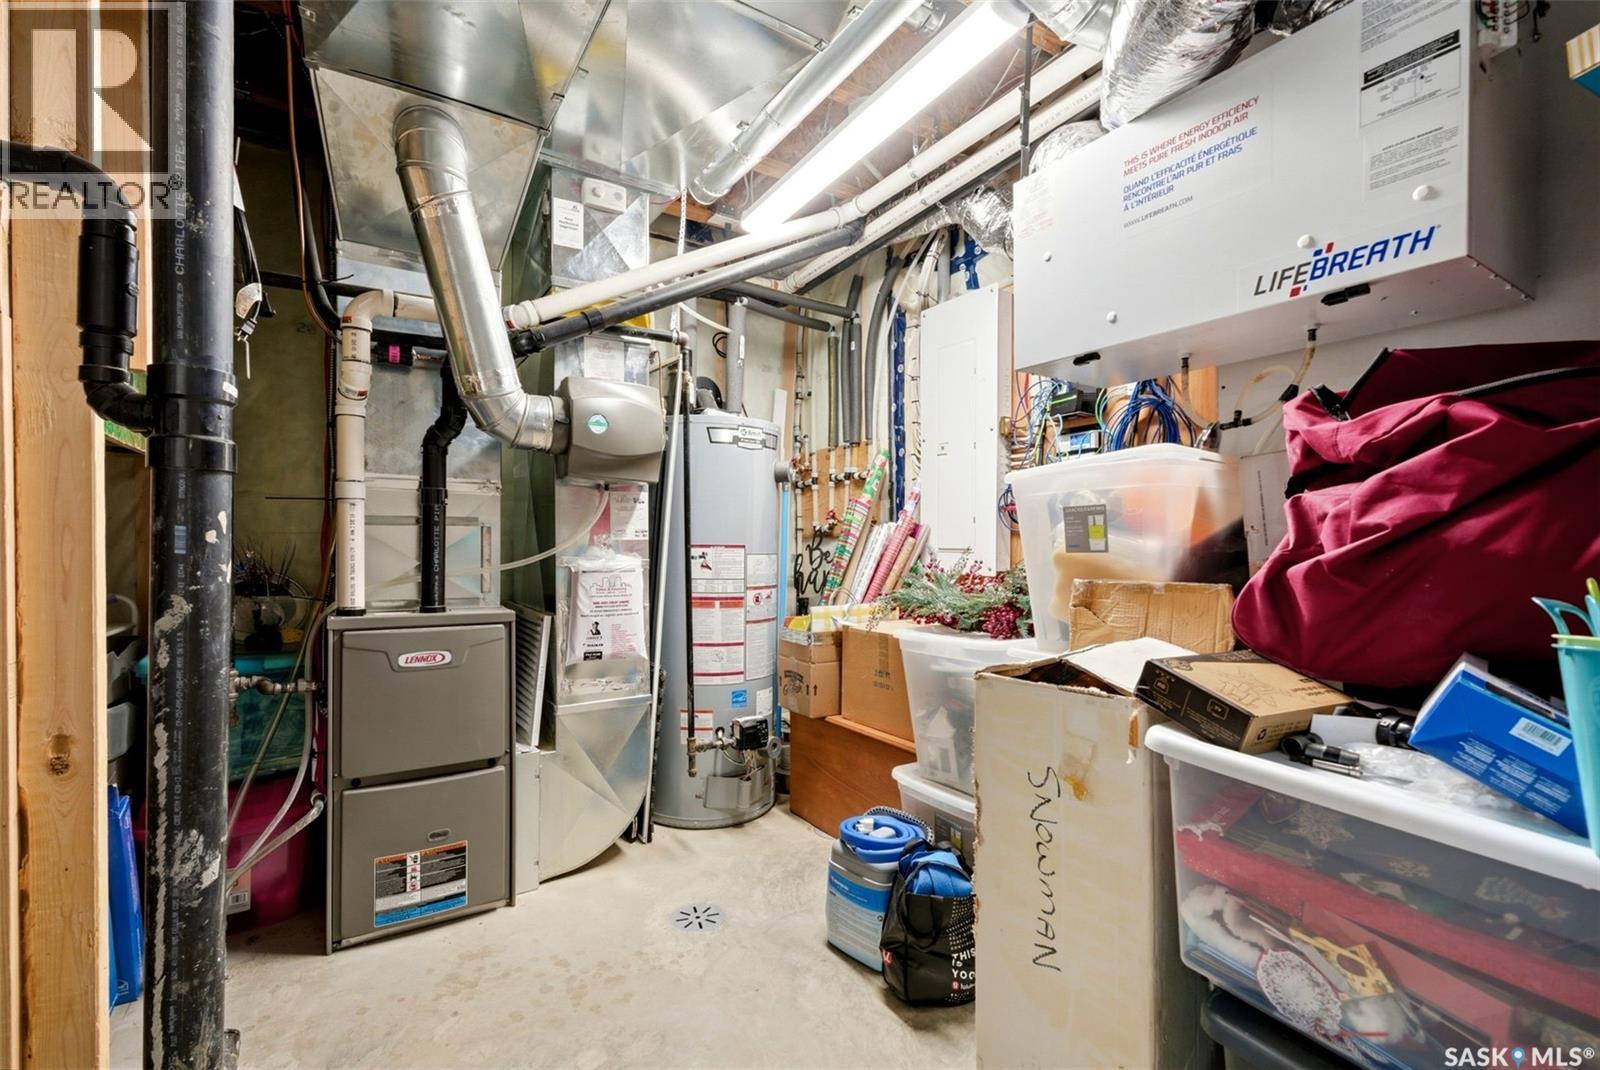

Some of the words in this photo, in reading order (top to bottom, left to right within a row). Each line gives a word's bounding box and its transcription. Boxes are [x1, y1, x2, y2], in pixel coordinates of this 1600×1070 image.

[1123, 159, 1148, 177] MEETS
[1148, 148, 1169, 166] PURE
[1170, 137, 1196, 155] FRESH
[1198, 121, 1231, 142] INDOOR
[1233, 111, 1249, 125] AIR
[1123, 176, 1150, 194] QUAND
[1197, 126, 1258, 160] ÉNERGÉTIQUE
[1124, 154, 1140, 168] THIS
[1141, 151, 1148, 159] IS
[1149, 136, 1177, 156] WHERE
[1178, 119, 1211, 141] ENERGY
[1211, 96, 1259, 126] EFFICIENCY
[1123, 178, 1166, 203] RENCONTRE
[1167, 168, 1185, 184] L'AIR
[1186, 161, 1204, 175] PUR
[1205, 155, 1216, 167] ET
[1217, 144, 1243, 161] FRAIS
[175, 192, 186, 275] CHARLOTTE
[1253, 225, 1436, 297] LIFEBREATH
[404, 654, 438, 664] LENNOX
[951, 947, 976, 961] THIS
